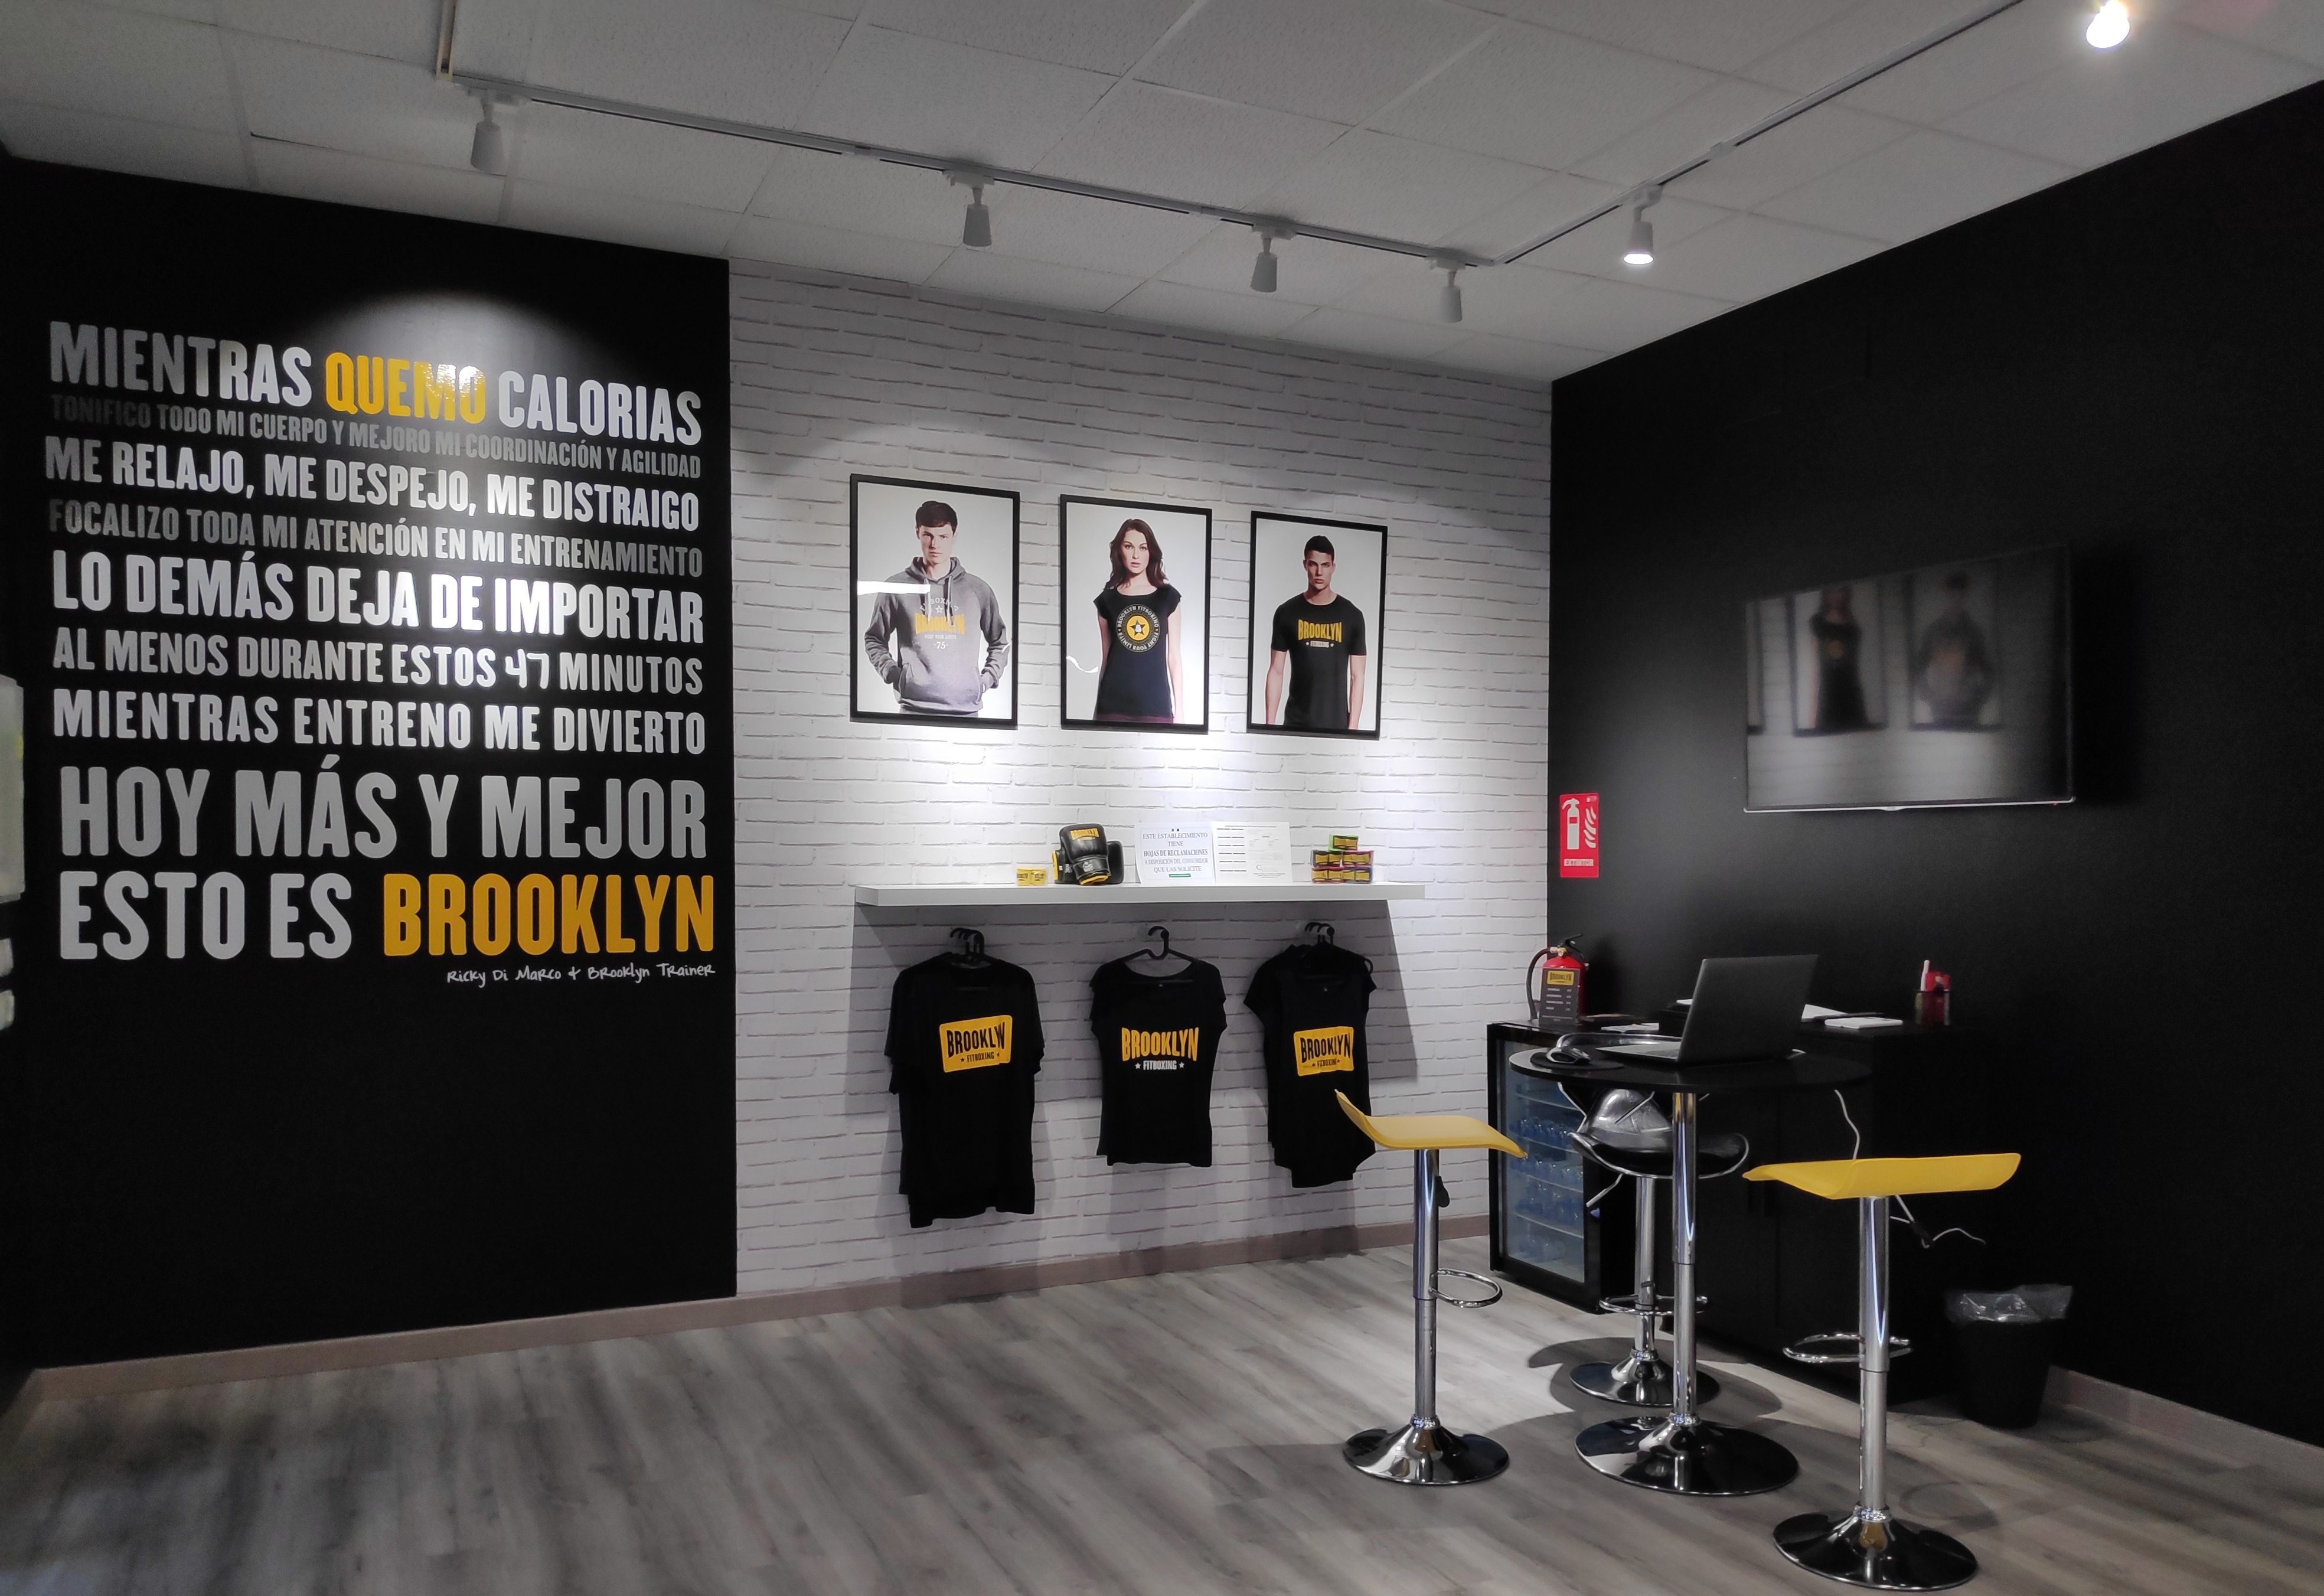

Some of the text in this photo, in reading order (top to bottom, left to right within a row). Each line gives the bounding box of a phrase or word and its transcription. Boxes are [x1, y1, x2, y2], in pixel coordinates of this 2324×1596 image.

[50, 321, 701, 446] MIENTRAS QUEMO CALORIAS
[51, 394, 701, 479] TONIFICO TODO MI CUERPO Y MEJORO MI COORDINACIÓN Y AGILIDAD
[45, 436, 699, 531] ME RELAJO, ME DESPEJO, ME DISTRAIGO
[50, 499, 703, 577] FOCALIZO TODA MI ATENCIÓN EN MI ENTRENAMIENTO
[53, 550, 704, 644] LO DEMÁS DEJA DE IMPORTAR
[1117, 606, 1160, 628] BROOKLYN FITBOXING
[936, 641, 946, 650] 75
[1298, 619, 1342, 643] BROOKLYN
[53, 626, 703, 695] AL MENOS DURANTE ESTOS 47 MINUTOS
[54, 688, 706, 755] MIENTRAS ENTRENO ME DIVIERTO
[61, 753, 707, 859] HOY MÁS Y MEJOR
[60, 870, 714, 961] ESTO ES BROOKLYN
[447, 970, 486, 988] Ricky
[493, 968, 508, 981] Di
[946, 1021, 1006, 1059] BROOKLYN
[967, 1052, 995, 1063] FITBOXING
[1121, 1027, 1199, 1062] BROOKLYN
[1143, 1060, 1177, 1070] FITBOXING
[1300, 1032, 1350, 1063] BROOKLYN
